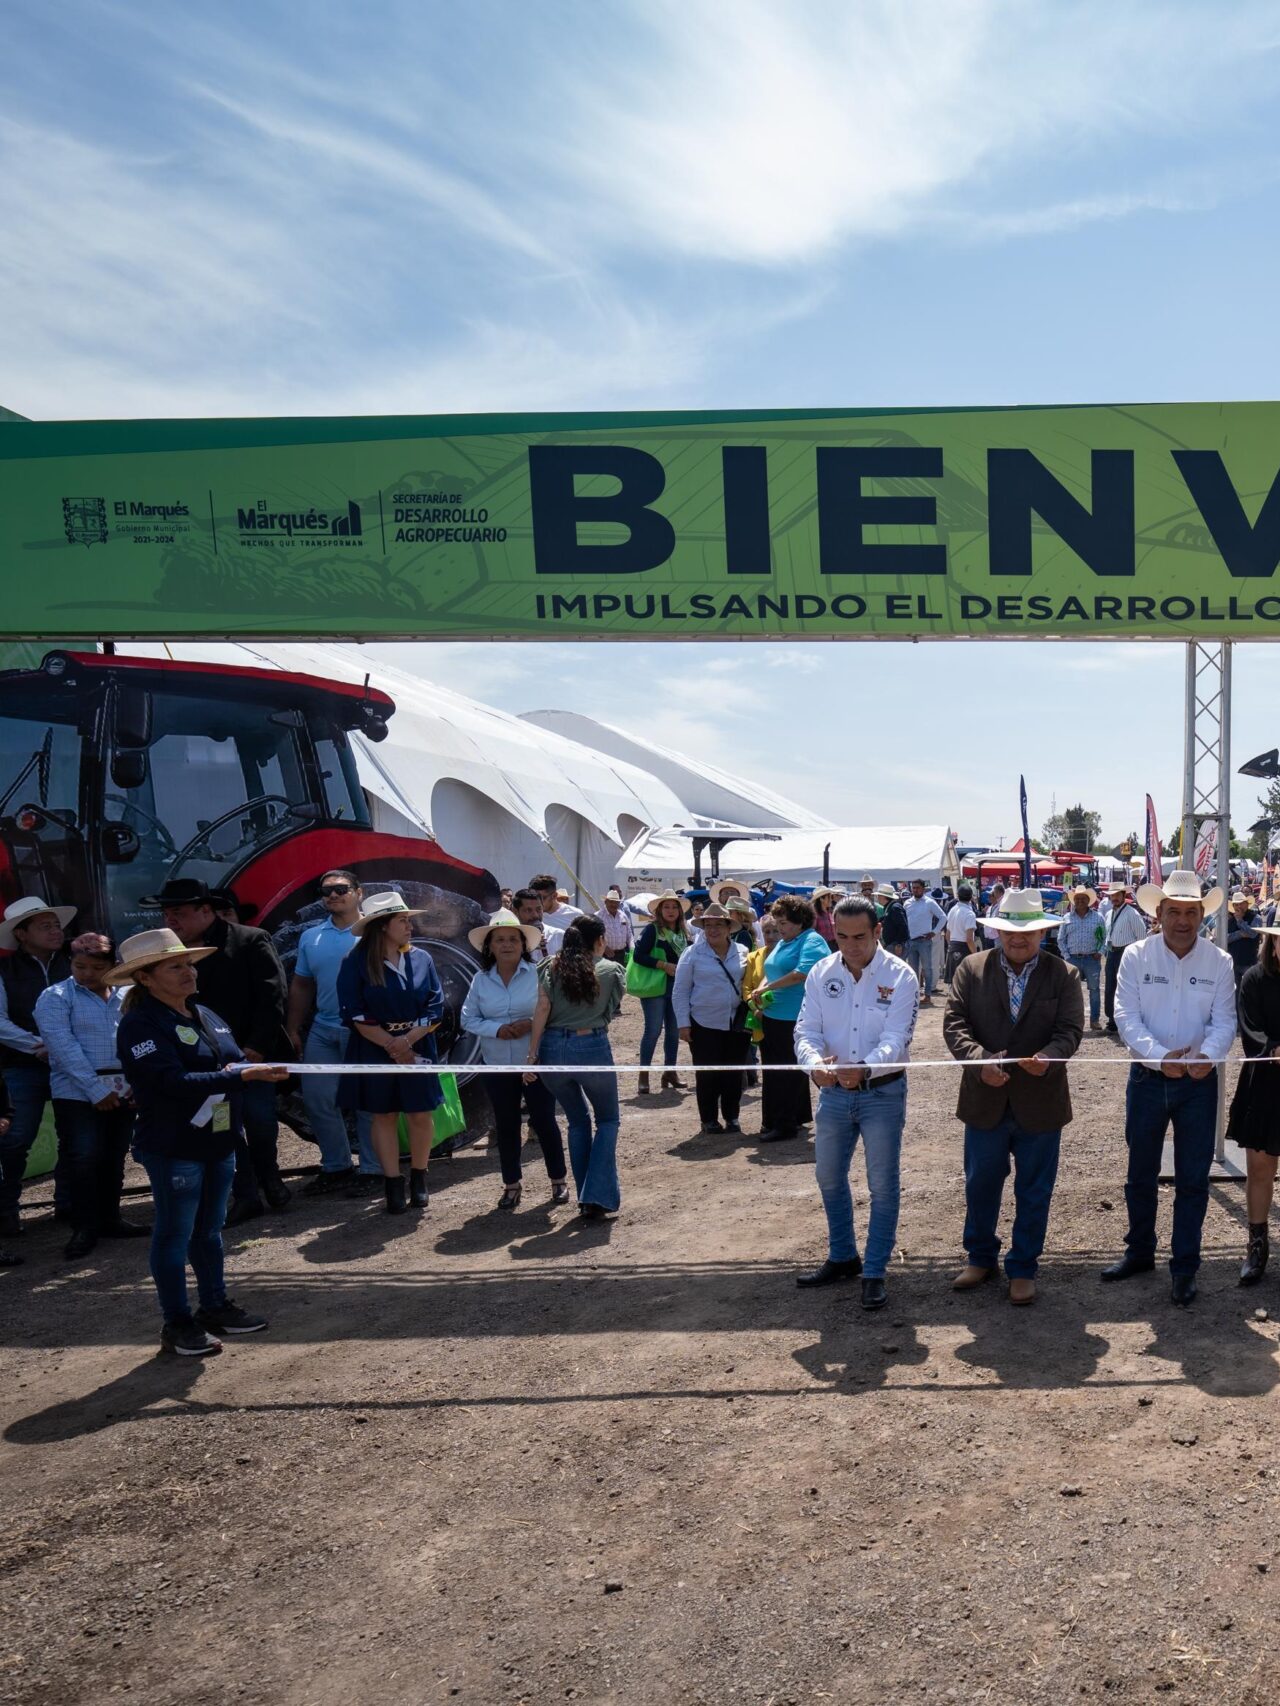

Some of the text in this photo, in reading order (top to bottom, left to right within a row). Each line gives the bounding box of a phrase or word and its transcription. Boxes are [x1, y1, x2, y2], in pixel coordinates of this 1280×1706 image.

[393, 492, 462, 503] SECRETARÍA DE
[114, 501, 189, 520] El Marqués
[257, 500, 267, 512] El
[238, 508, 329, 537] Marqués
[395, 508, 489, 523] DESARROLLO
[116, 524, 151, 532] Gobierno
[396, 527, 507, 543] AGROPECUARIO
[536, 594, 867, 620] IMPULSANDO
[886, 596, 943, 620] EL
[131, 1040, 154, 1054] EXPO
